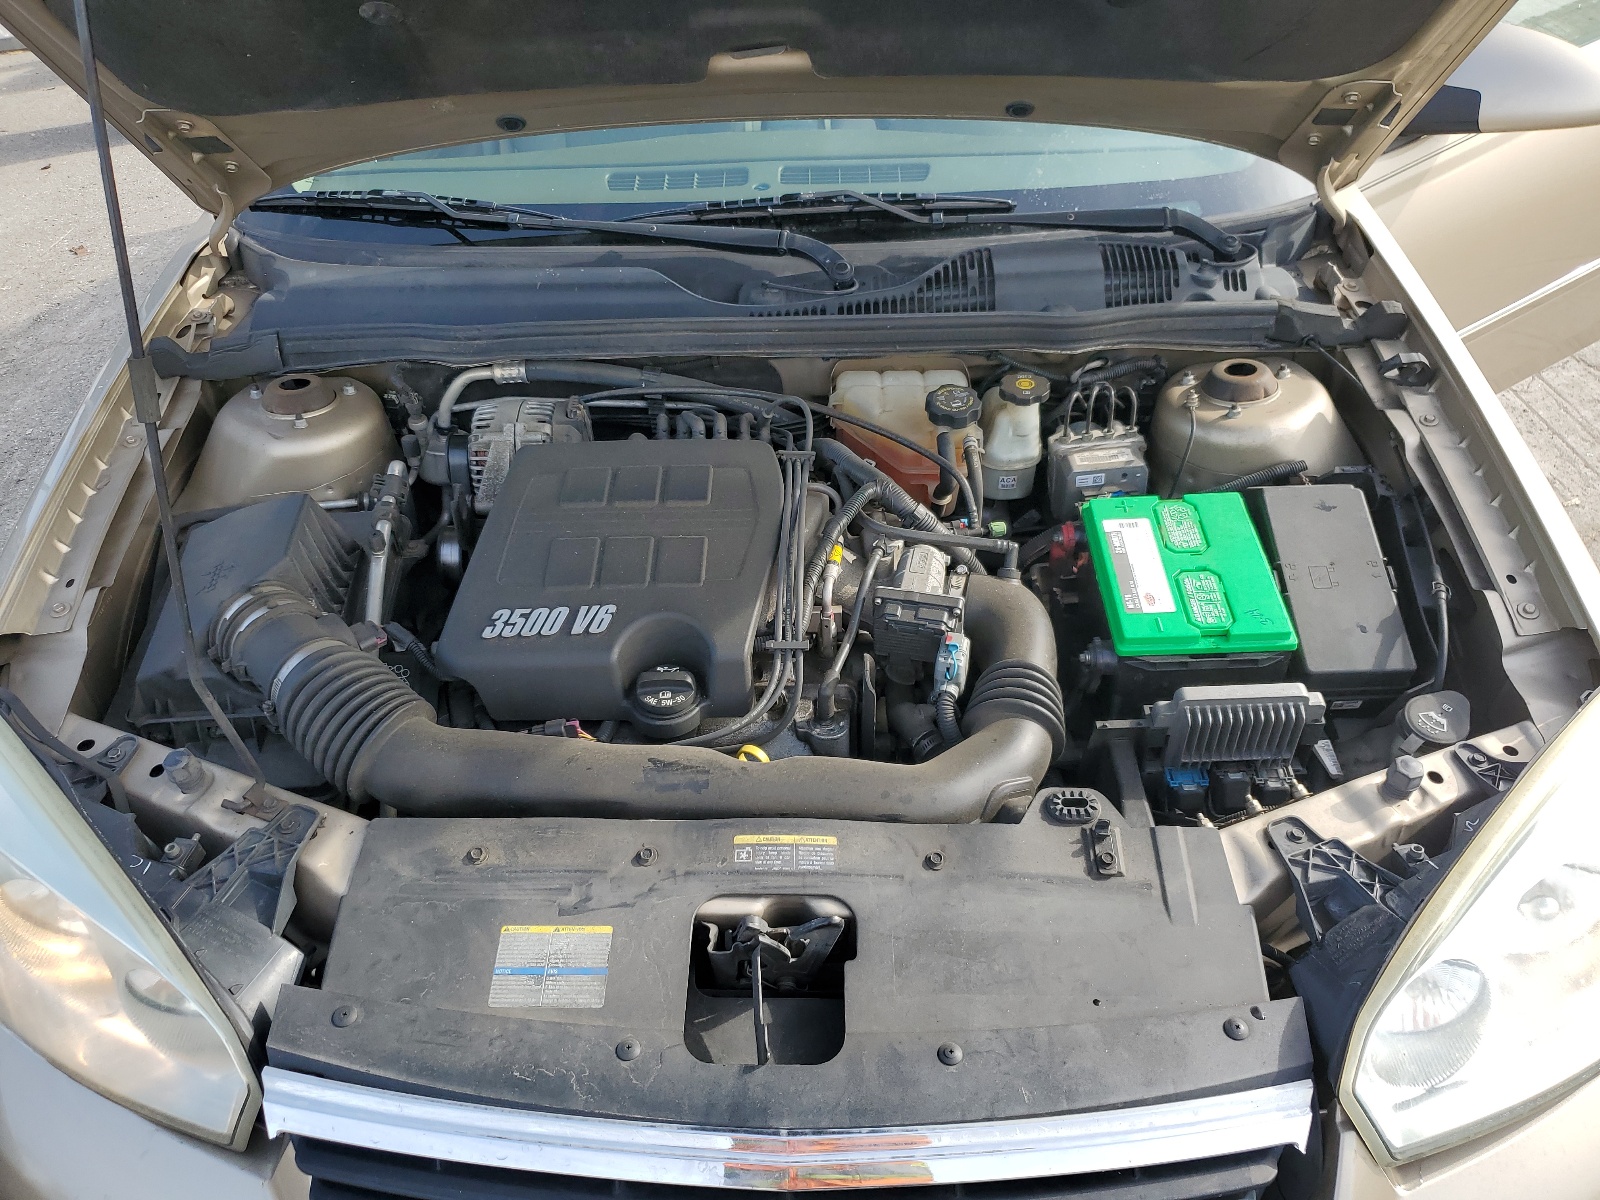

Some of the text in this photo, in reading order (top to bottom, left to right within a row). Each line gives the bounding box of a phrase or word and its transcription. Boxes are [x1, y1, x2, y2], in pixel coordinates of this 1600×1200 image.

[481, 604, 617, 639] 3500 V6
[644, 694, 686, 706] SAE 5W-30
